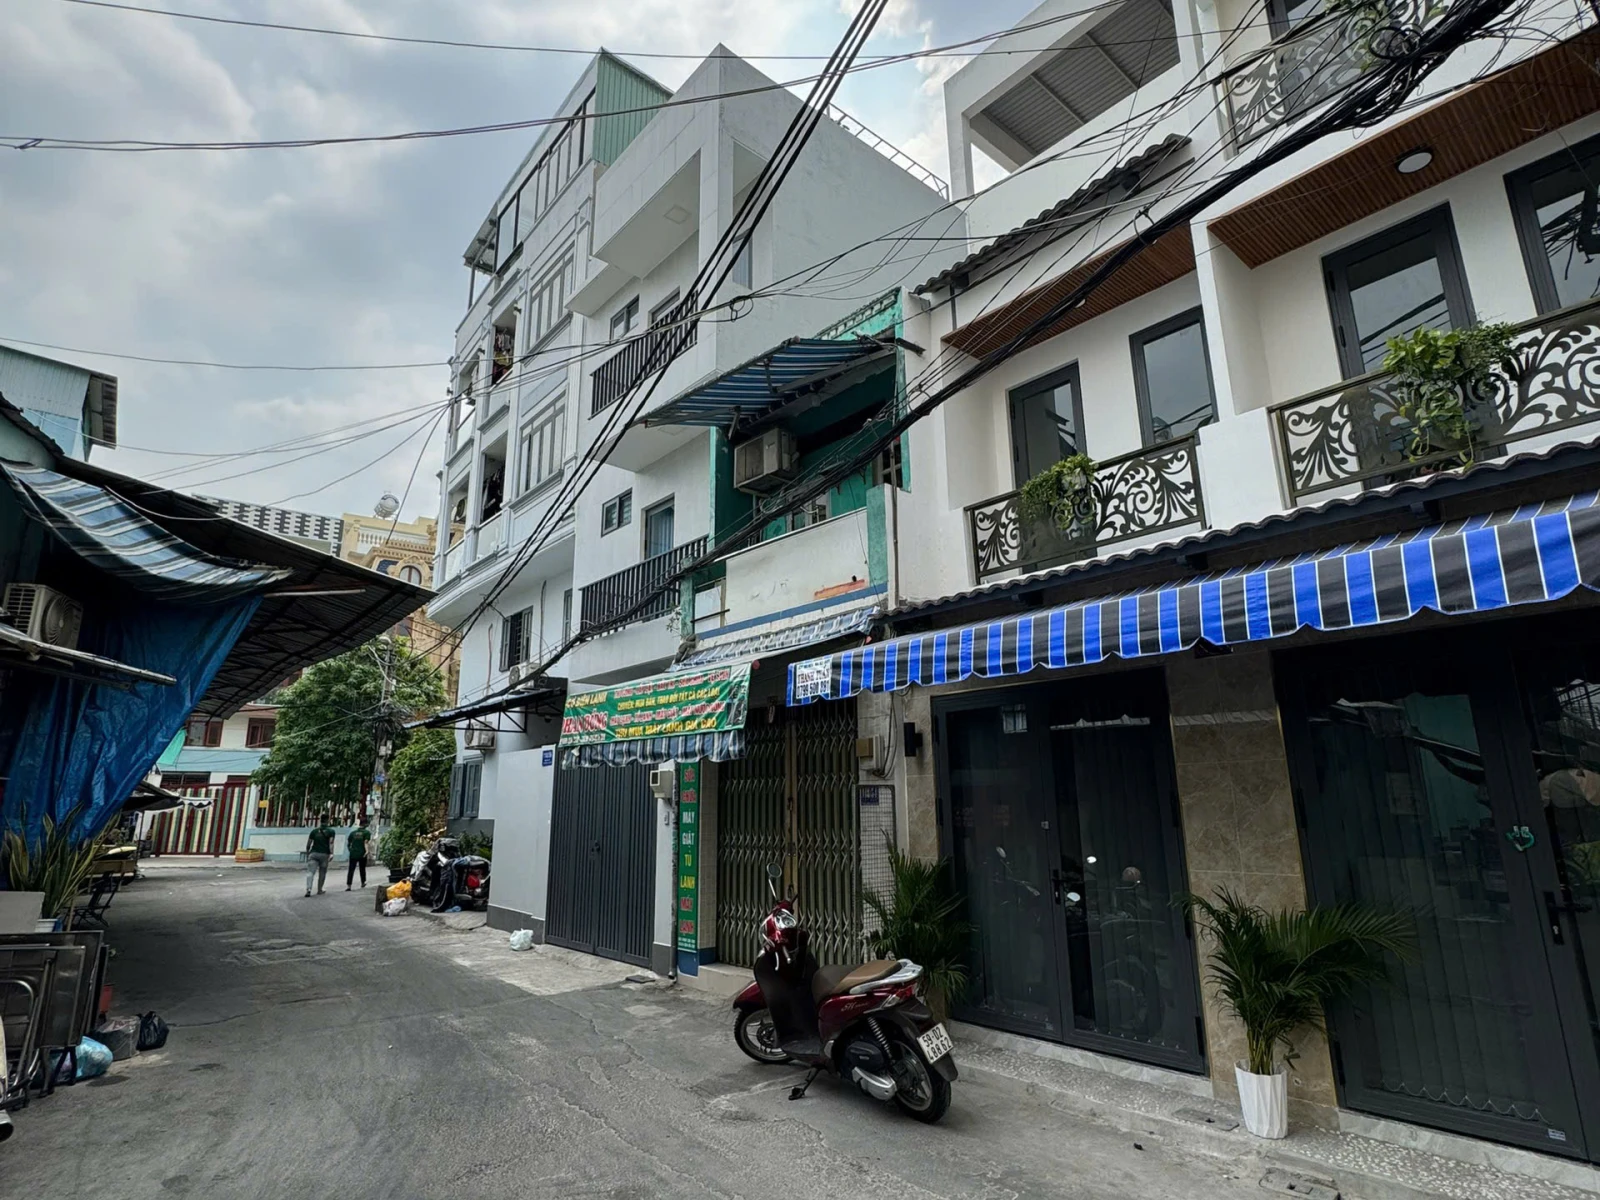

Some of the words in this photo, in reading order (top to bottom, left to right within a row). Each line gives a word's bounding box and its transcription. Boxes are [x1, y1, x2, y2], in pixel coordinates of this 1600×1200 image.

[683, 809, 695, 824] MÁY
[682, 830, 695, 847] GIẶT
[684, 850, 692, 866] TỦ
